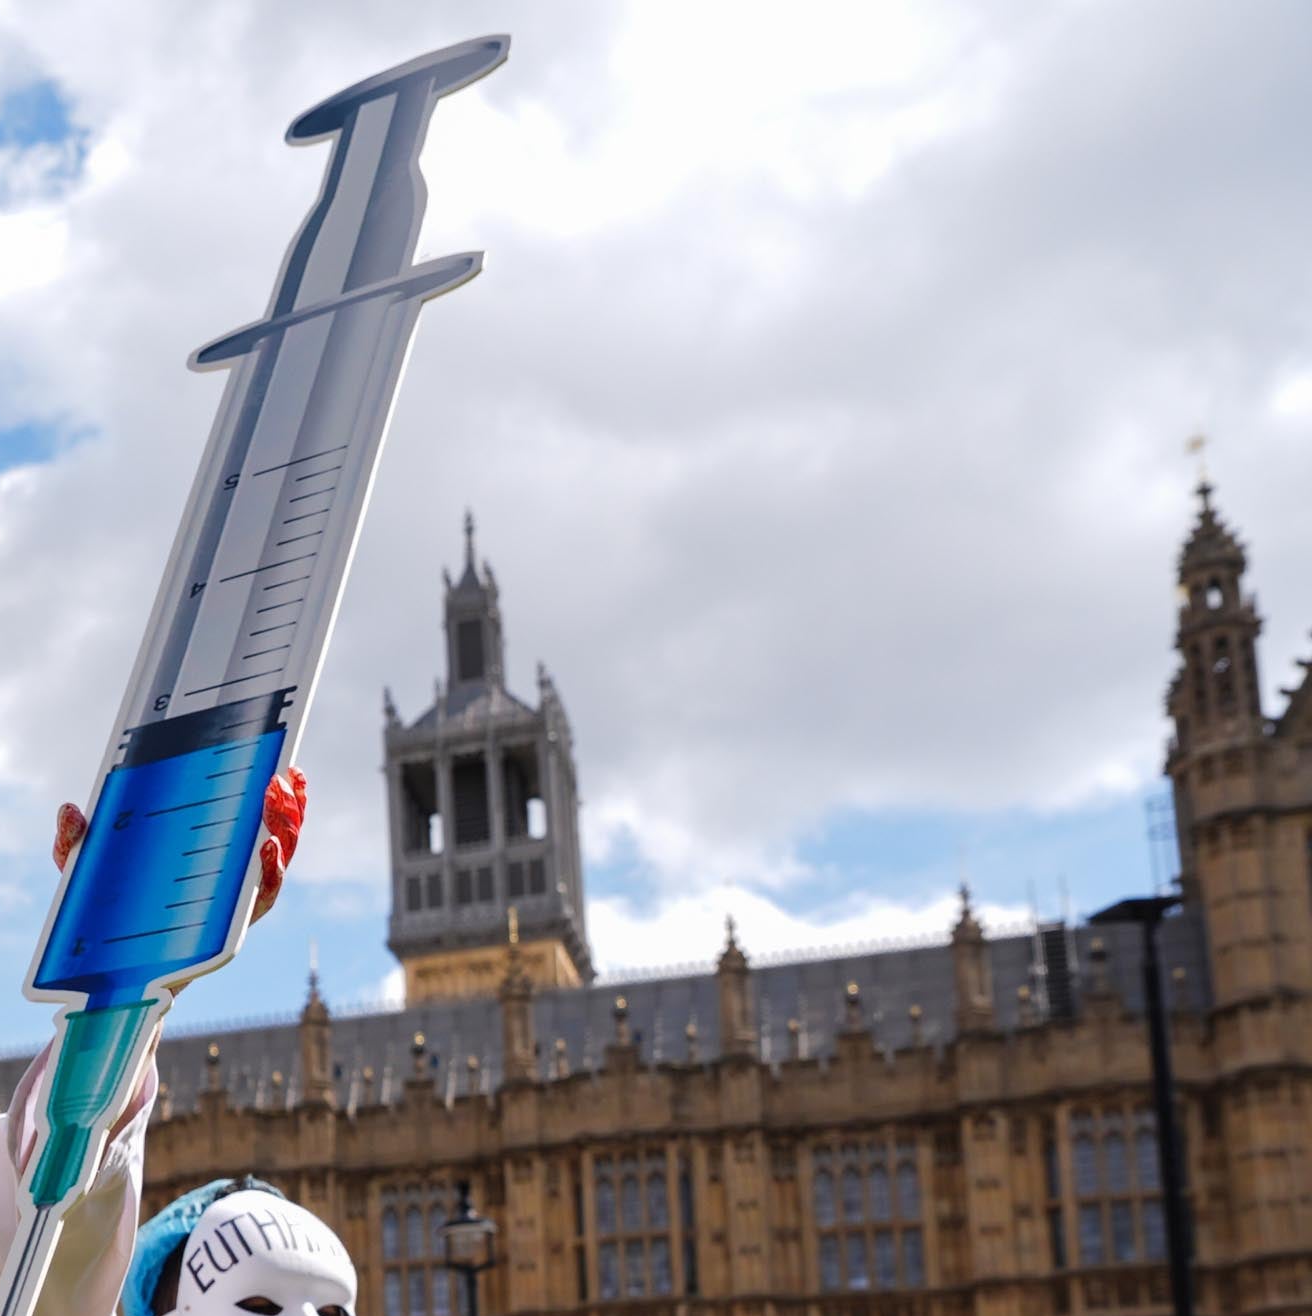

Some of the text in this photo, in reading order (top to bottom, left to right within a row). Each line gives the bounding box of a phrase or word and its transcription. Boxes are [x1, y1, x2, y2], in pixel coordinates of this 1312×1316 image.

[224, 474, 241, 490] 5
[190, 581, 207, 599] 4
[153, 693, 172, 711] 3
